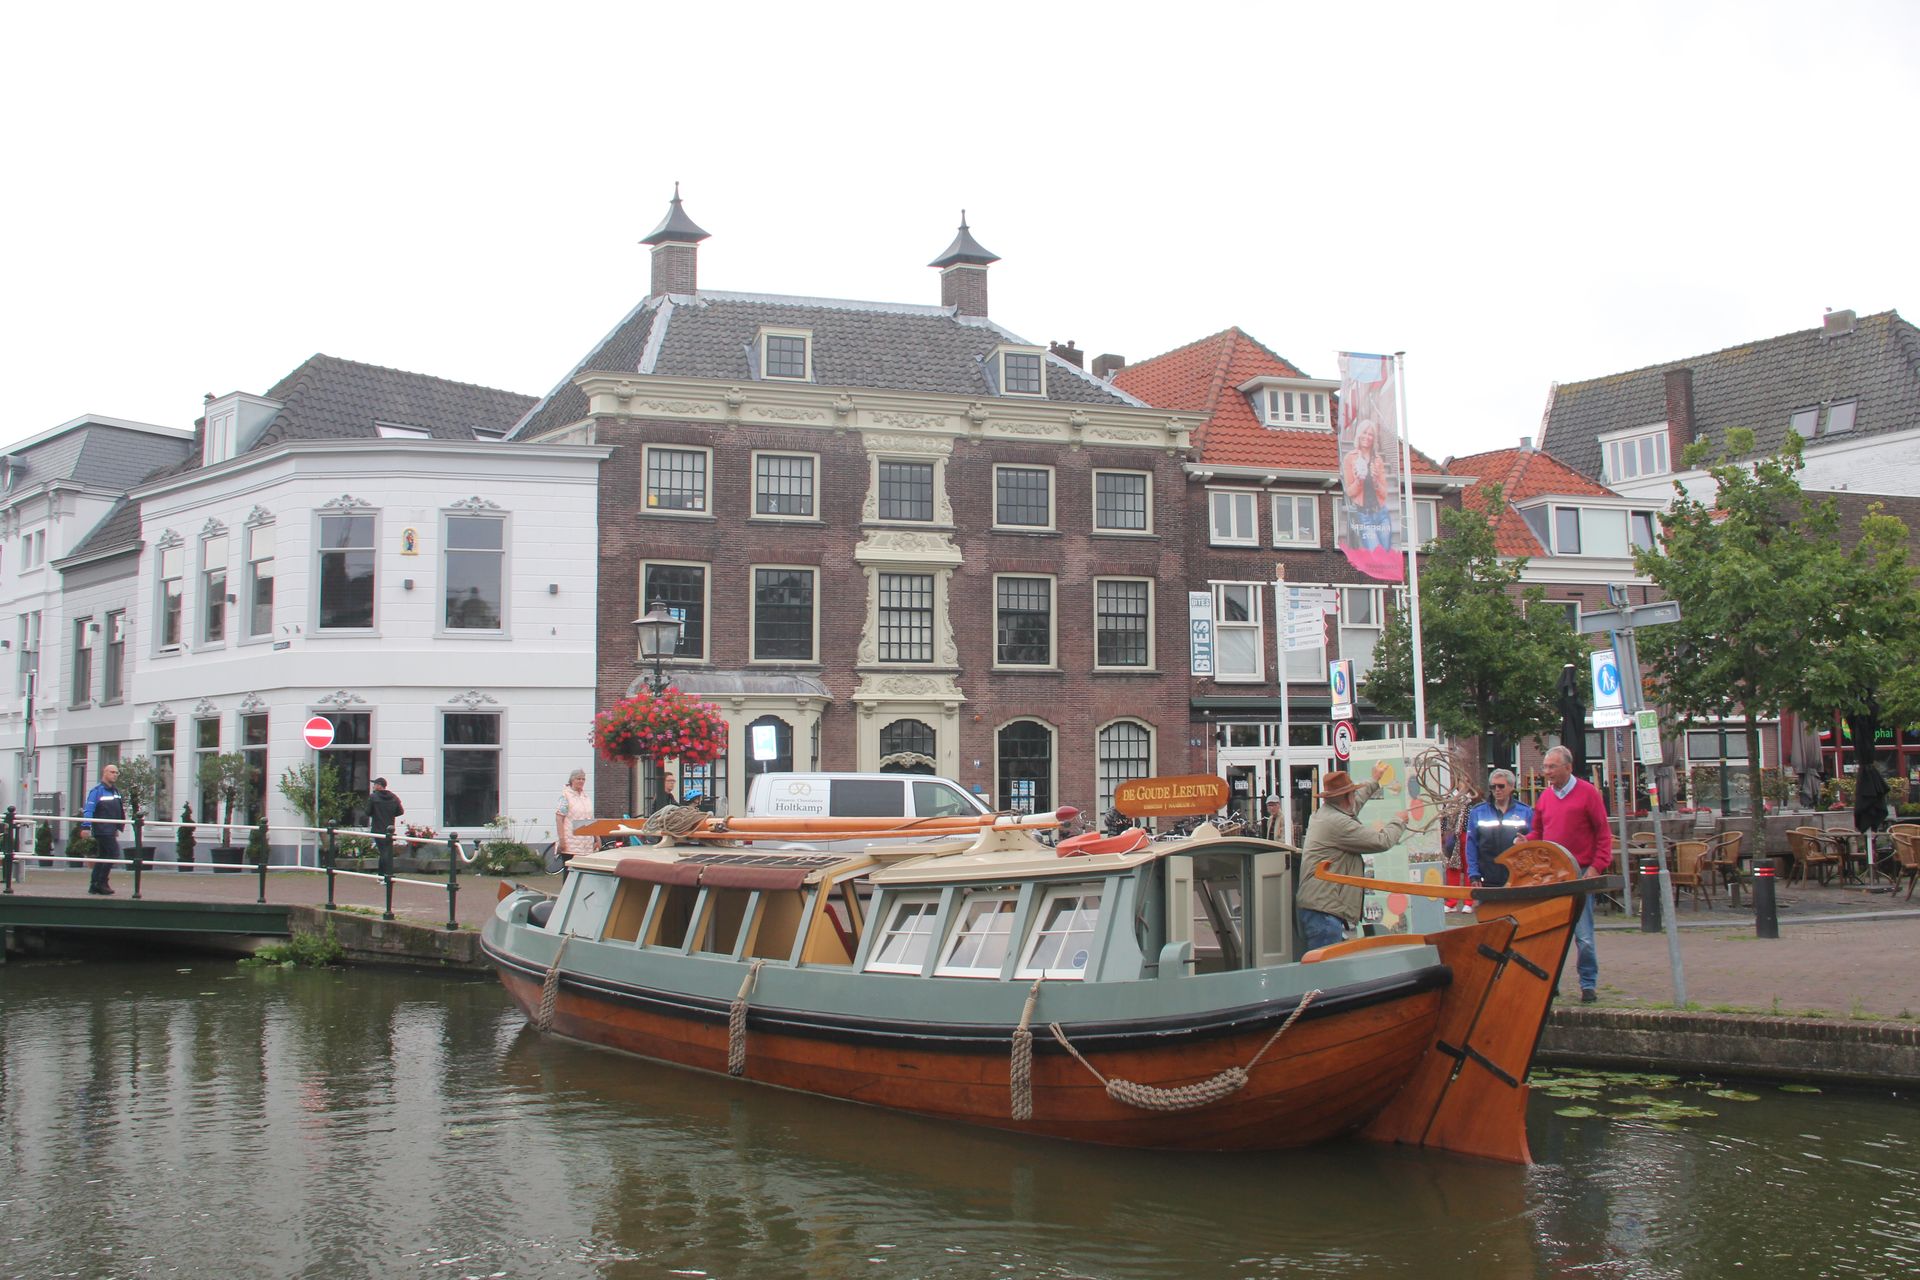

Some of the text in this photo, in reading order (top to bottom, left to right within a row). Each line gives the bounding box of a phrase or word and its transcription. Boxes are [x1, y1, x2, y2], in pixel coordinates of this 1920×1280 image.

[1191, 598, 1210, 607] BITES
[1193, 620, 1211, 672] BITES
[1123, 784, 1219, 801] DE GOUDE LEEUWIN
[775, 803, 823, 815] Holtkamp
